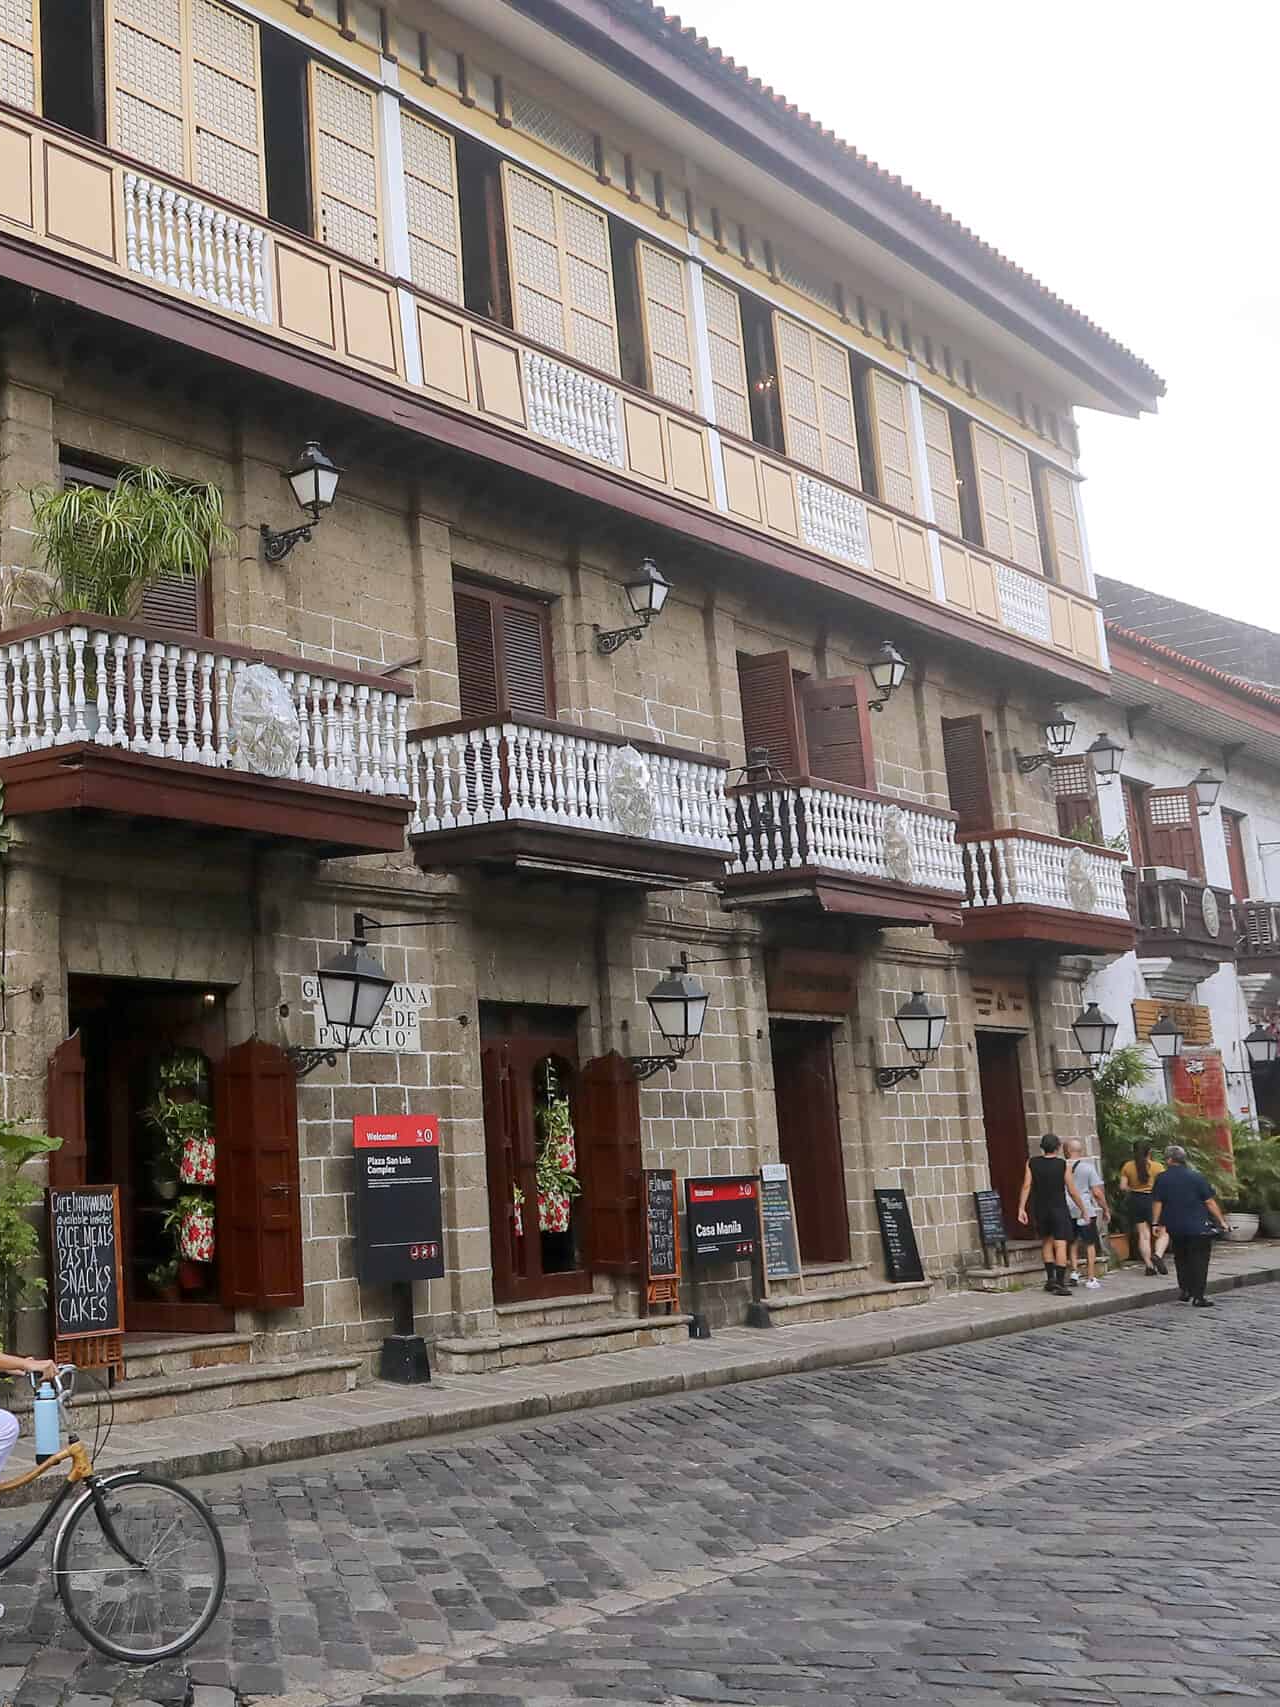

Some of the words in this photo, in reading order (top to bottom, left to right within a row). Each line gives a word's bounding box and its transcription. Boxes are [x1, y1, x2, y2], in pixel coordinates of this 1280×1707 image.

[387, 985, 428, 1004] UNA
[395, 1010, 417, 1028] DE
[366, 1131, 398, 1142] Welcome!
[367, 1155, 386, 1165] Plaza
[386, 1155, 399, 1165] San
[399, 1154, 412, 1165] Luis
[367, 1165, 396, 1176] Complex
[56, 1226, 80, 1249] RICE
[82, 1224, 114, 1249] MEALS
[695, 1223, 715, 1238] Casa
[716, 1220, 742, 1236] Manila
[58, 1246, 98, 1271] PASTA
[59, 1265, 112, 1296] SNACKS
[58, 1296, 108, 1323] CAKES
